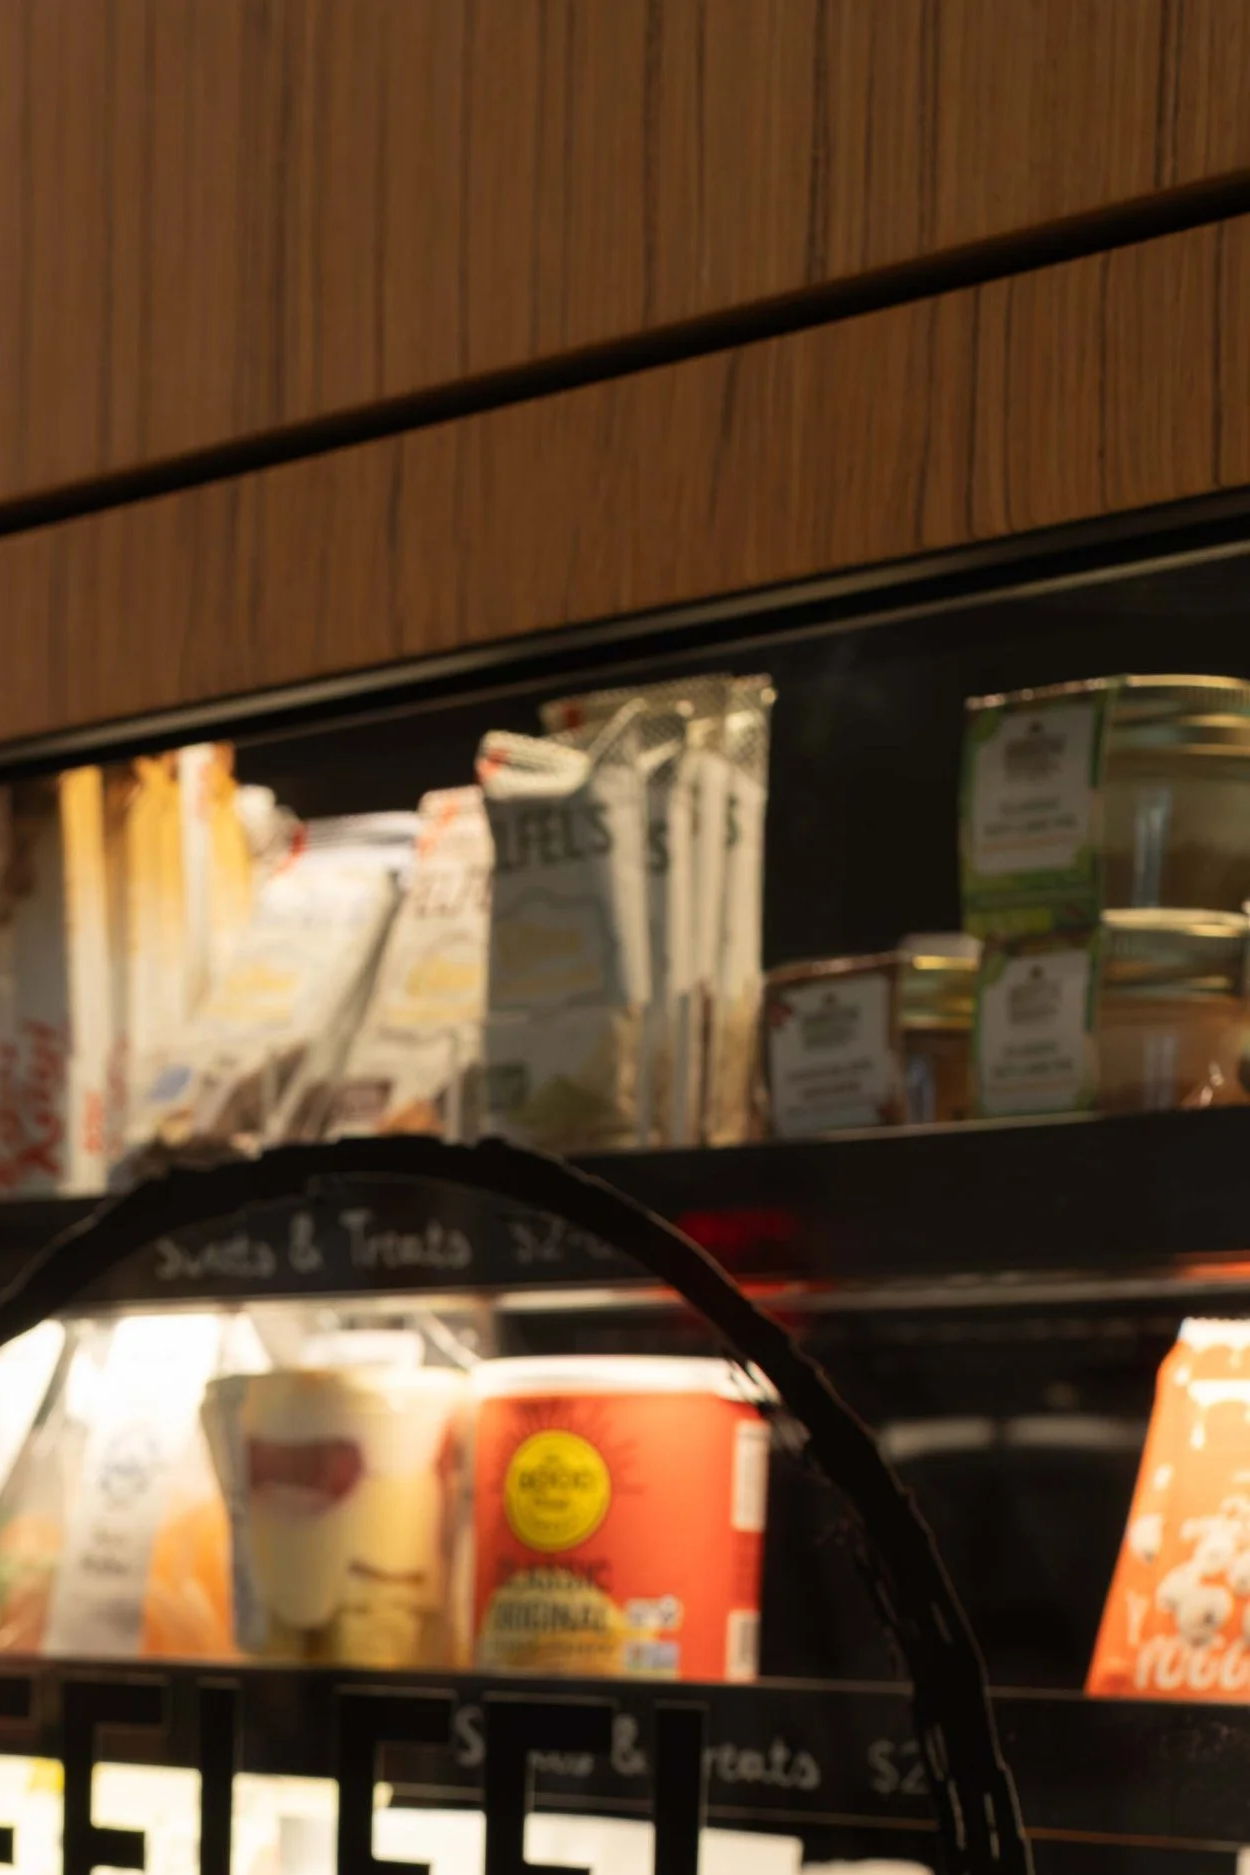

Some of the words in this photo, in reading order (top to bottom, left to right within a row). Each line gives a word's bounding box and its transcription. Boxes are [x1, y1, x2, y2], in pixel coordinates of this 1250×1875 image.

[288, 1211, 324, 1273] &
[339, 1206, 473, 1268] Treats
[703, 1736, 822, 1791] reats
